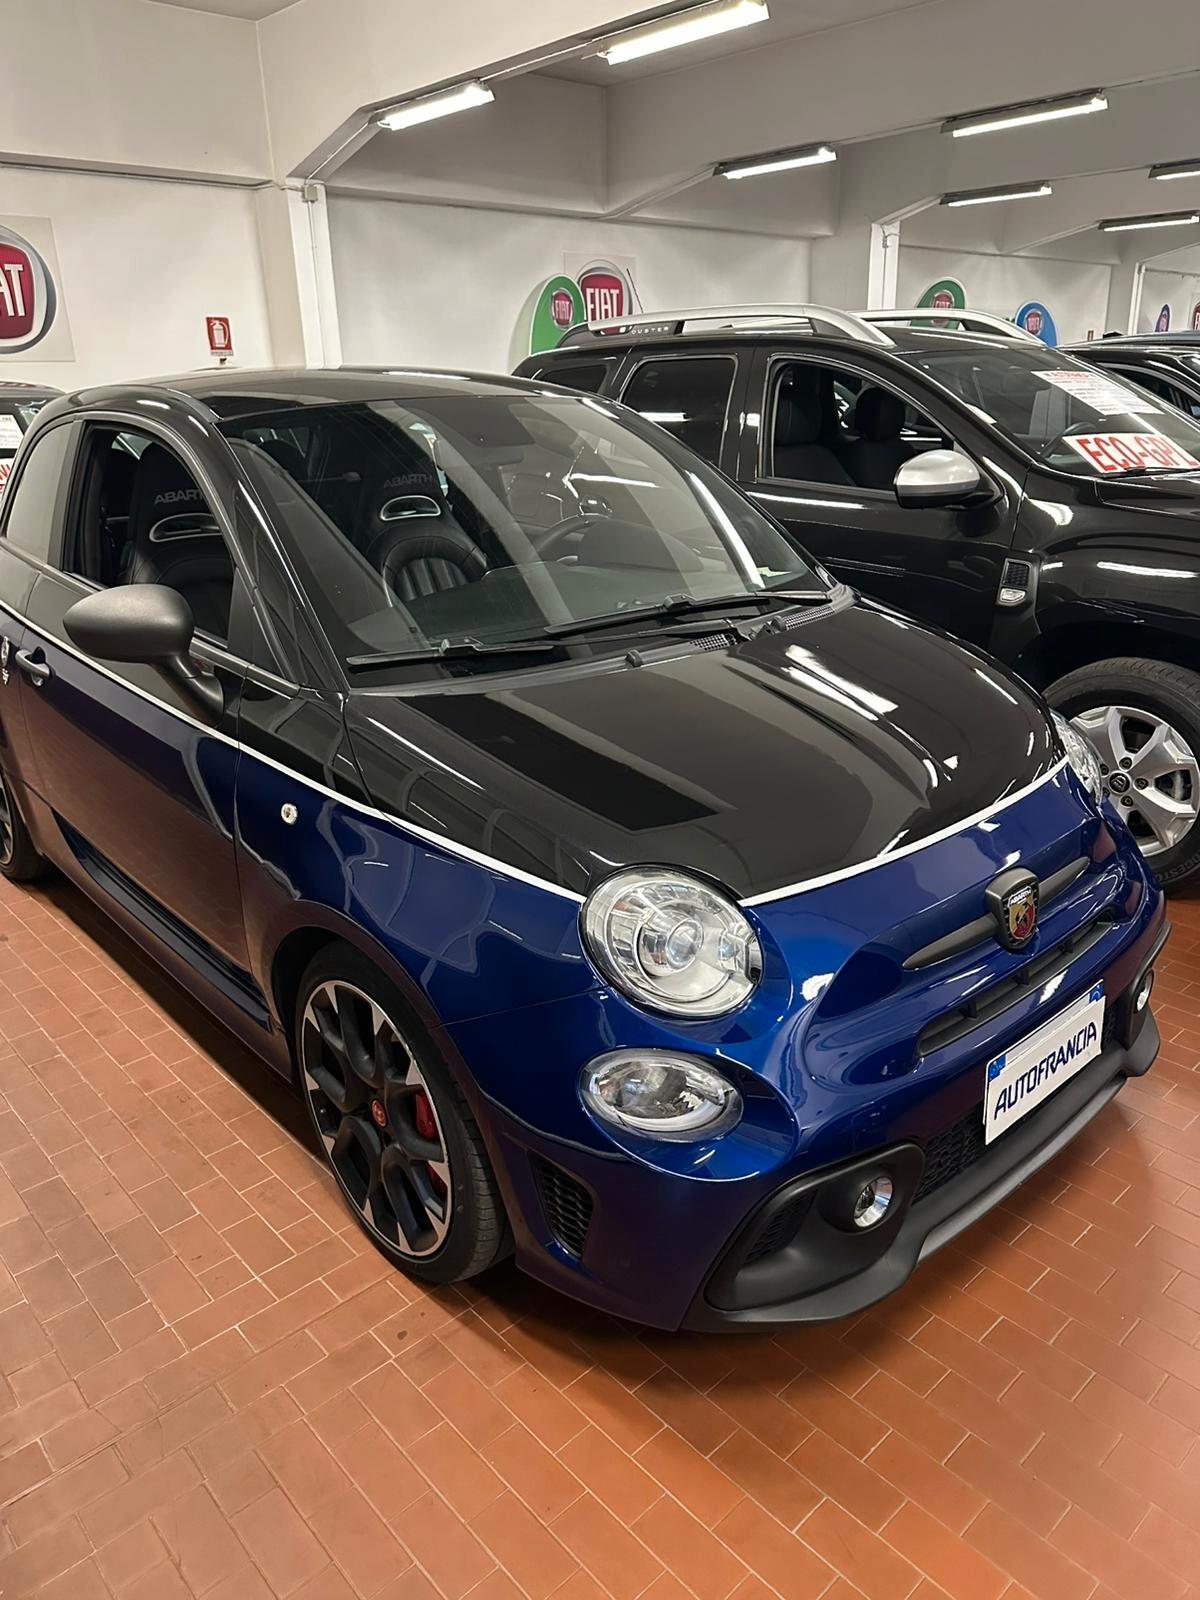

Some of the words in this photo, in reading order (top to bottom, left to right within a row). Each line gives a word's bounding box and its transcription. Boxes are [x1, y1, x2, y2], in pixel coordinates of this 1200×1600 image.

[586, 288, 619, 321] FIAT
[1076, 436, 1199, 471] ECO-GPL
[384, 474, 432, 488] ABARTH
[994, 1022, 1096, 1120] AUTOFRANCIA
